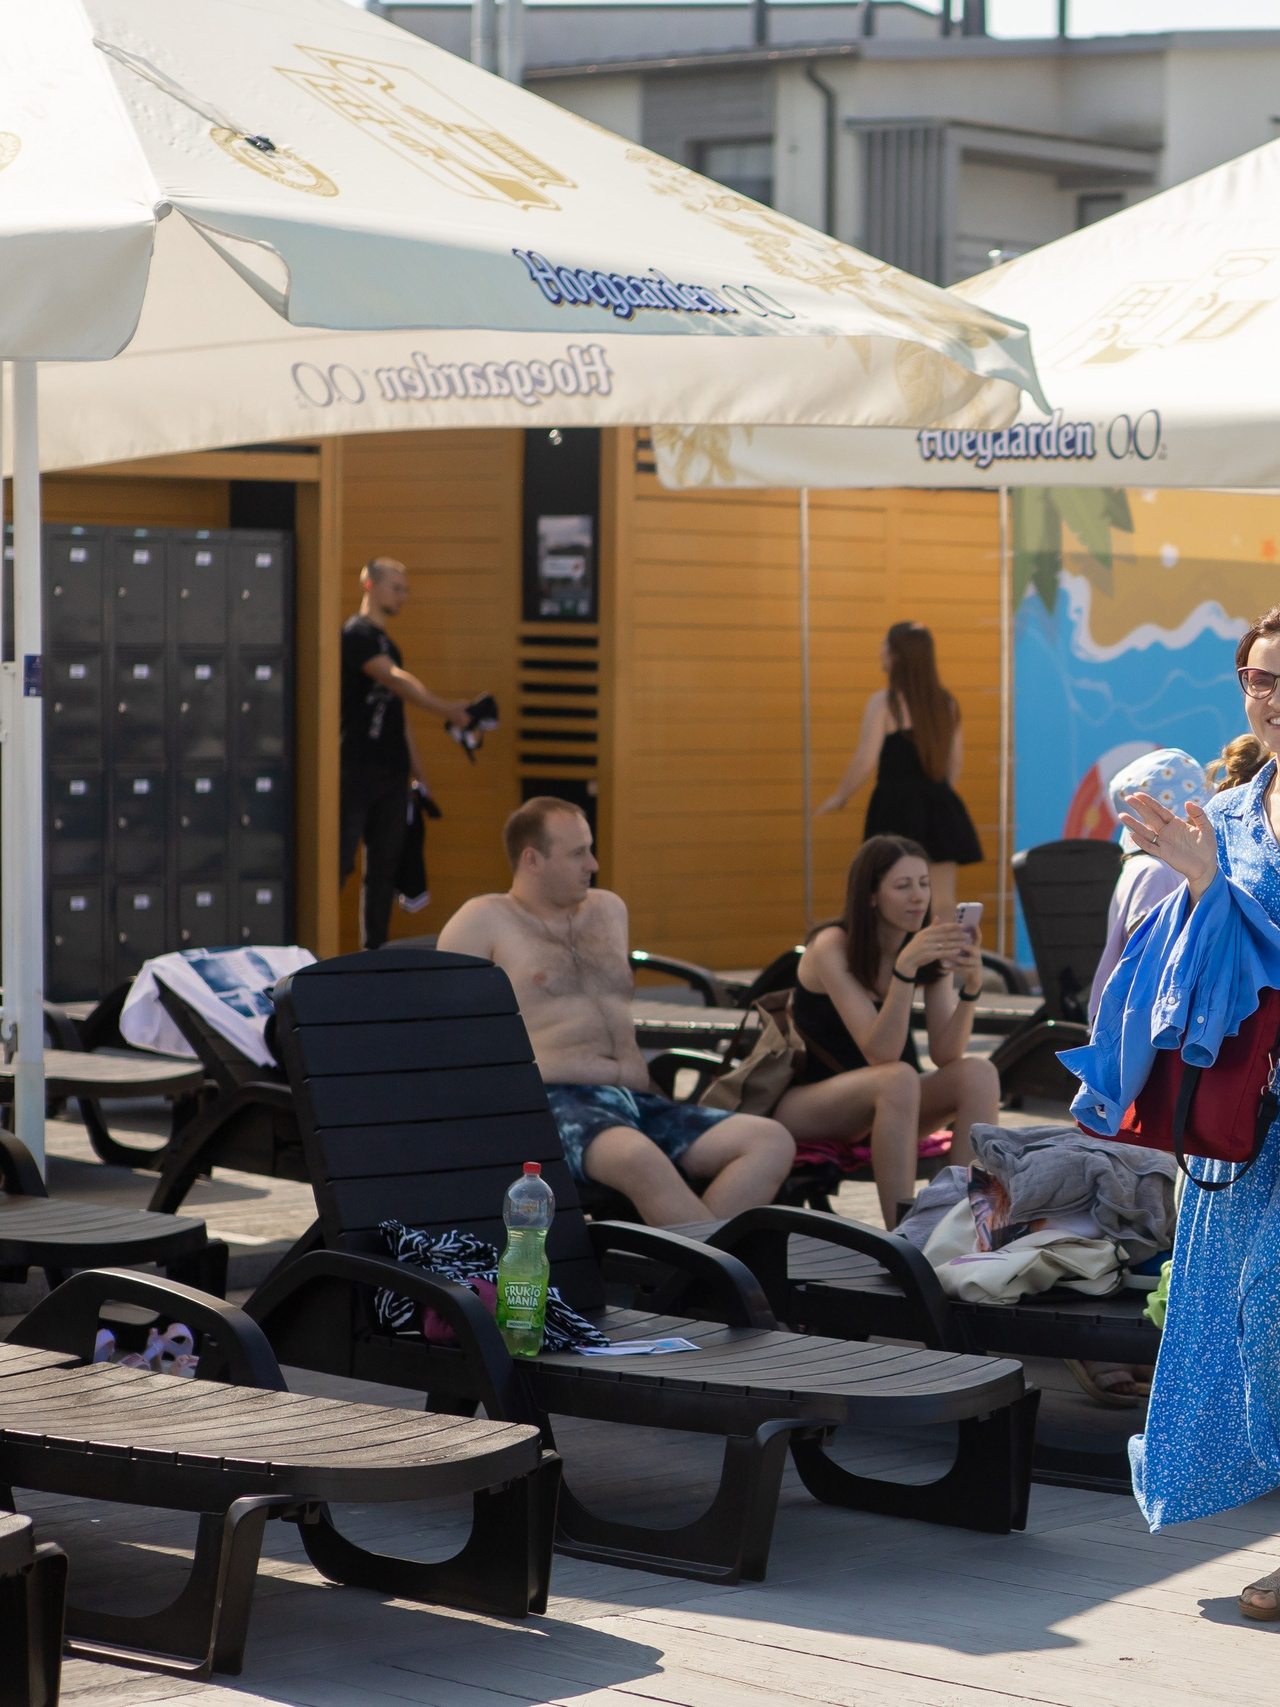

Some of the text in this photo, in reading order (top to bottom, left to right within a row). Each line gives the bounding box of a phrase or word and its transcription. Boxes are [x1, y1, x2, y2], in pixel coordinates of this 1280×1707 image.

[512, 248, 738, 320] Hoegaarden
[504, 1284, 541, 1298] FRUKTO
[507, 1295, 539, 1307] MANIA
